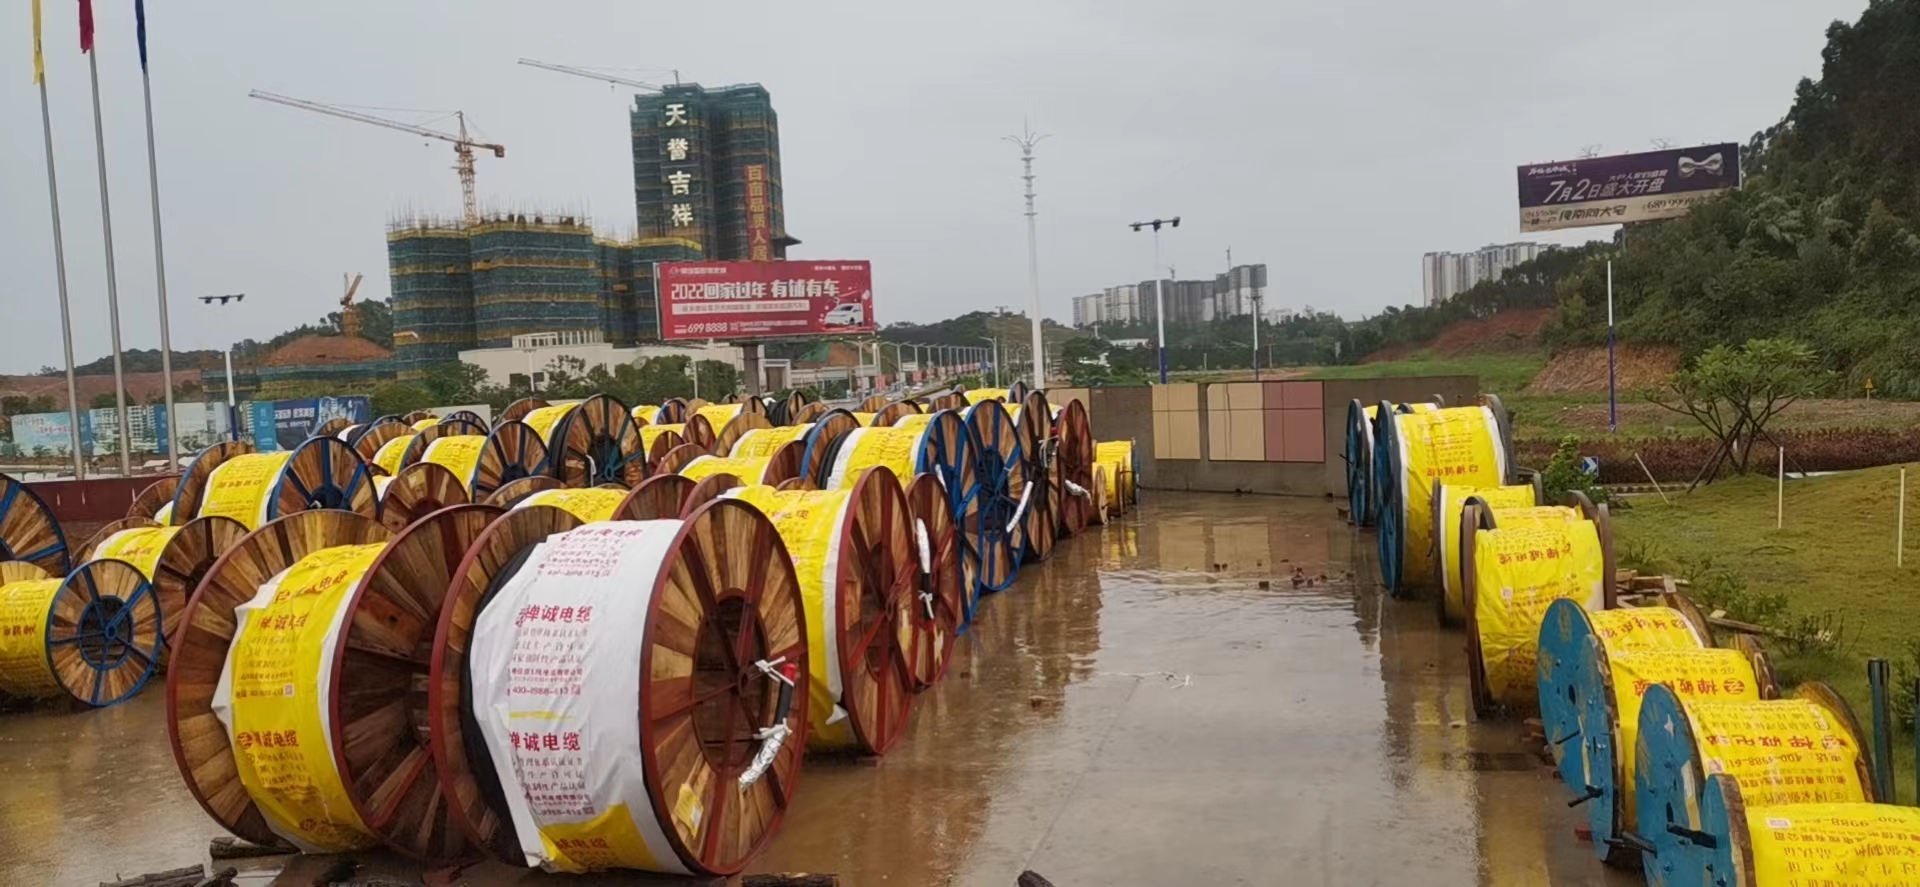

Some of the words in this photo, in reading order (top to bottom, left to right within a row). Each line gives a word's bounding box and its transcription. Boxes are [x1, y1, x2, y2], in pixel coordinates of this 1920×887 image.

[665, 103, 693, 227] 天誉吉祥
[1543, 178, 1666, 204] 7月2日盛大开盘
[671, 281, 767, 299] 2022回家过年
[770, 278, 841, 298] 有铺有车
